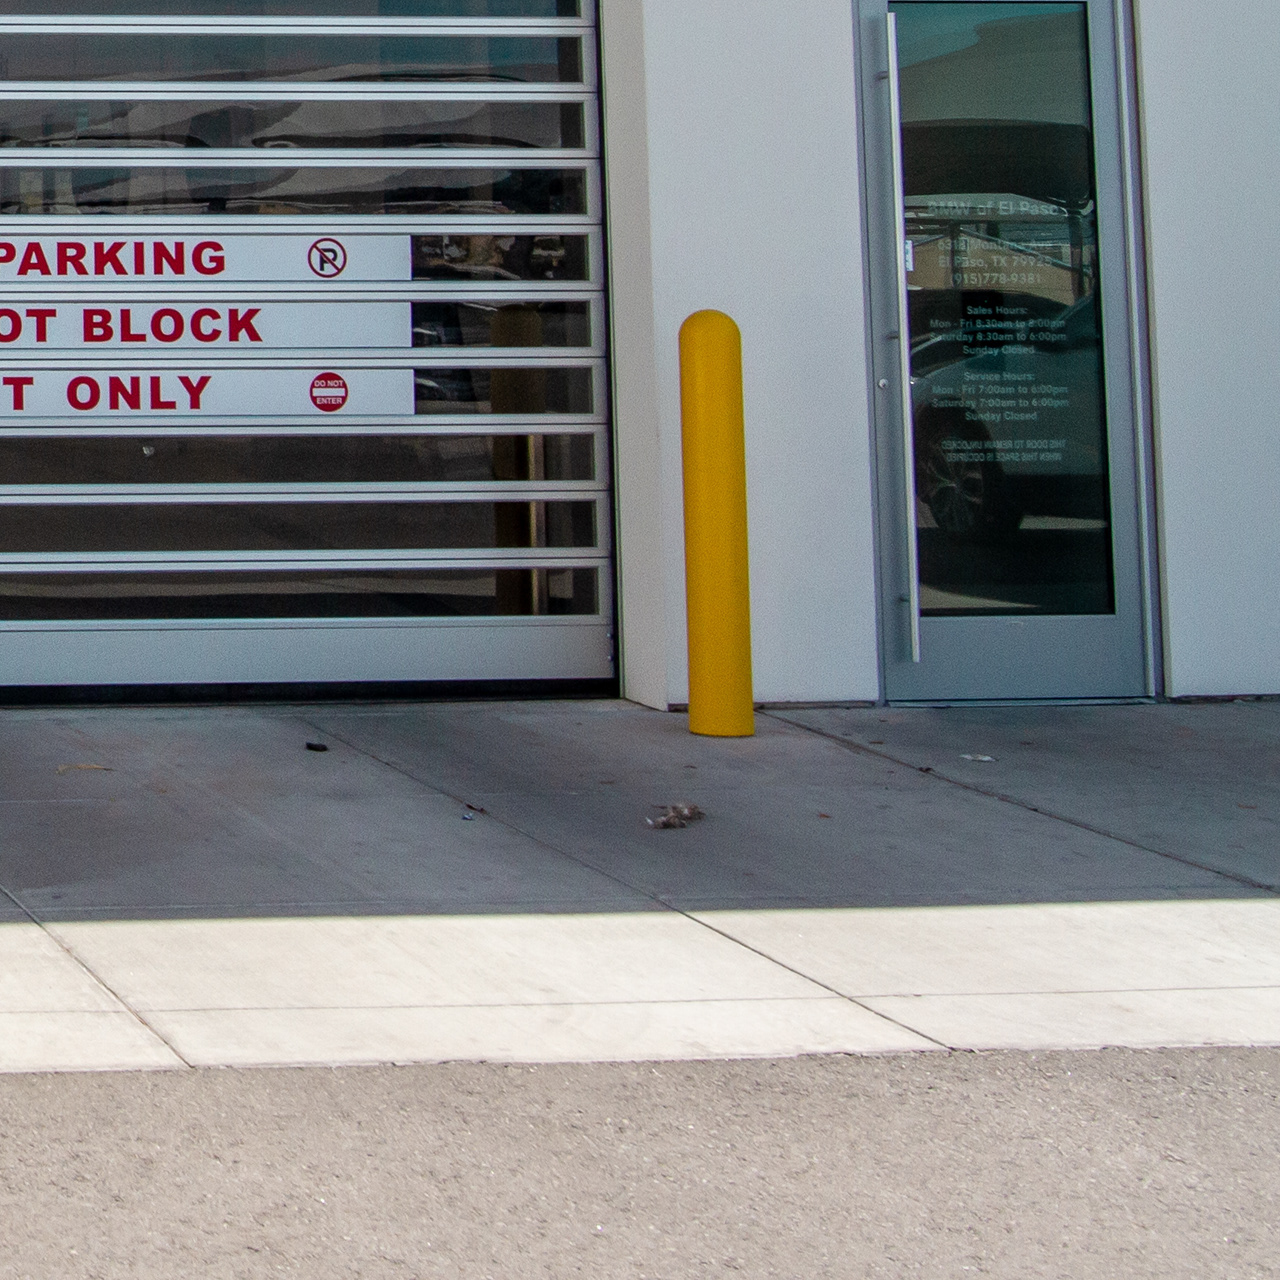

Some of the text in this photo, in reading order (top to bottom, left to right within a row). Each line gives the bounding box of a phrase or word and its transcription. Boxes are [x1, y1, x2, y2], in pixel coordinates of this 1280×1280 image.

[992, 255, 1007, 267] TX
[951, 272, 1042, 286] 915)778-9381
[966, 305, 993, 315] Sales
[83, 309, 260, 342] BLOCK
[67, 376, 209, 410] ONLY
